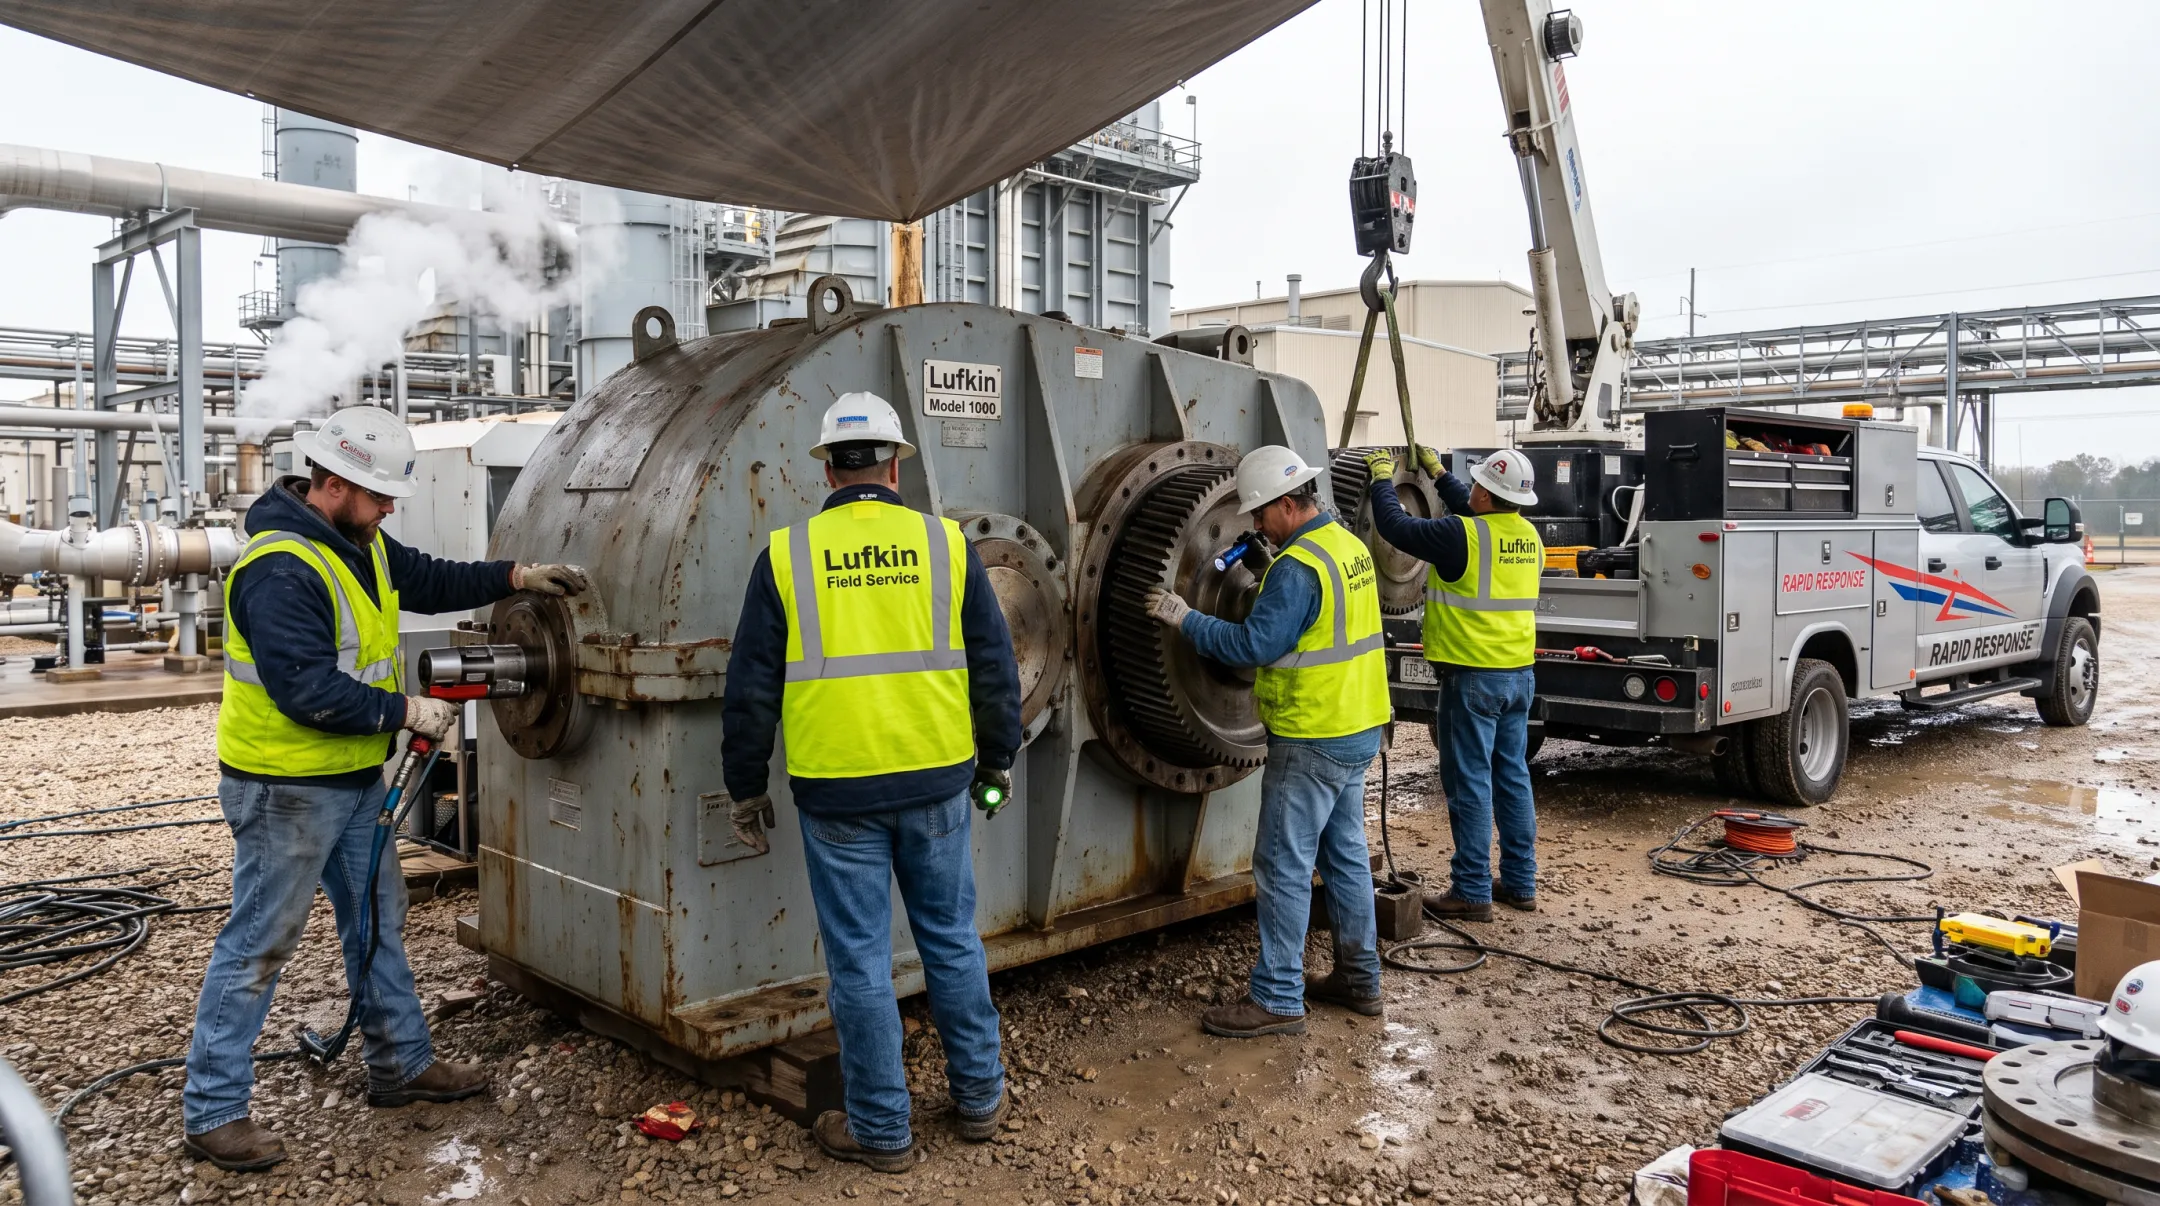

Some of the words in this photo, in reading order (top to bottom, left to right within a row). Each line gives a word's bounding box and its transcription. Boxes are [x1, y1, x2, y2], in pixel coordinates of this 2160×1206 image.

[929, 366, 996, 393] Lufkin
[929, 398, 965, 413] Model
[969, 401, 996, 415] 1000
[823, 544, 919, 572] Lufkin
[1499, 538, 1536, 554] Lufkin
[1342, 553, 1373, 580] Lufkin
[826, 574, 862, 589] Field
[865, 571, 920, 587] Service
[1781, 573, 1814, 593] RAPID
[1815, 570, 1866, 591] RESPONSE
[1929, 638, 1972, 667] RAPID
[1972, 629, 2035, 660] RESPONSE
